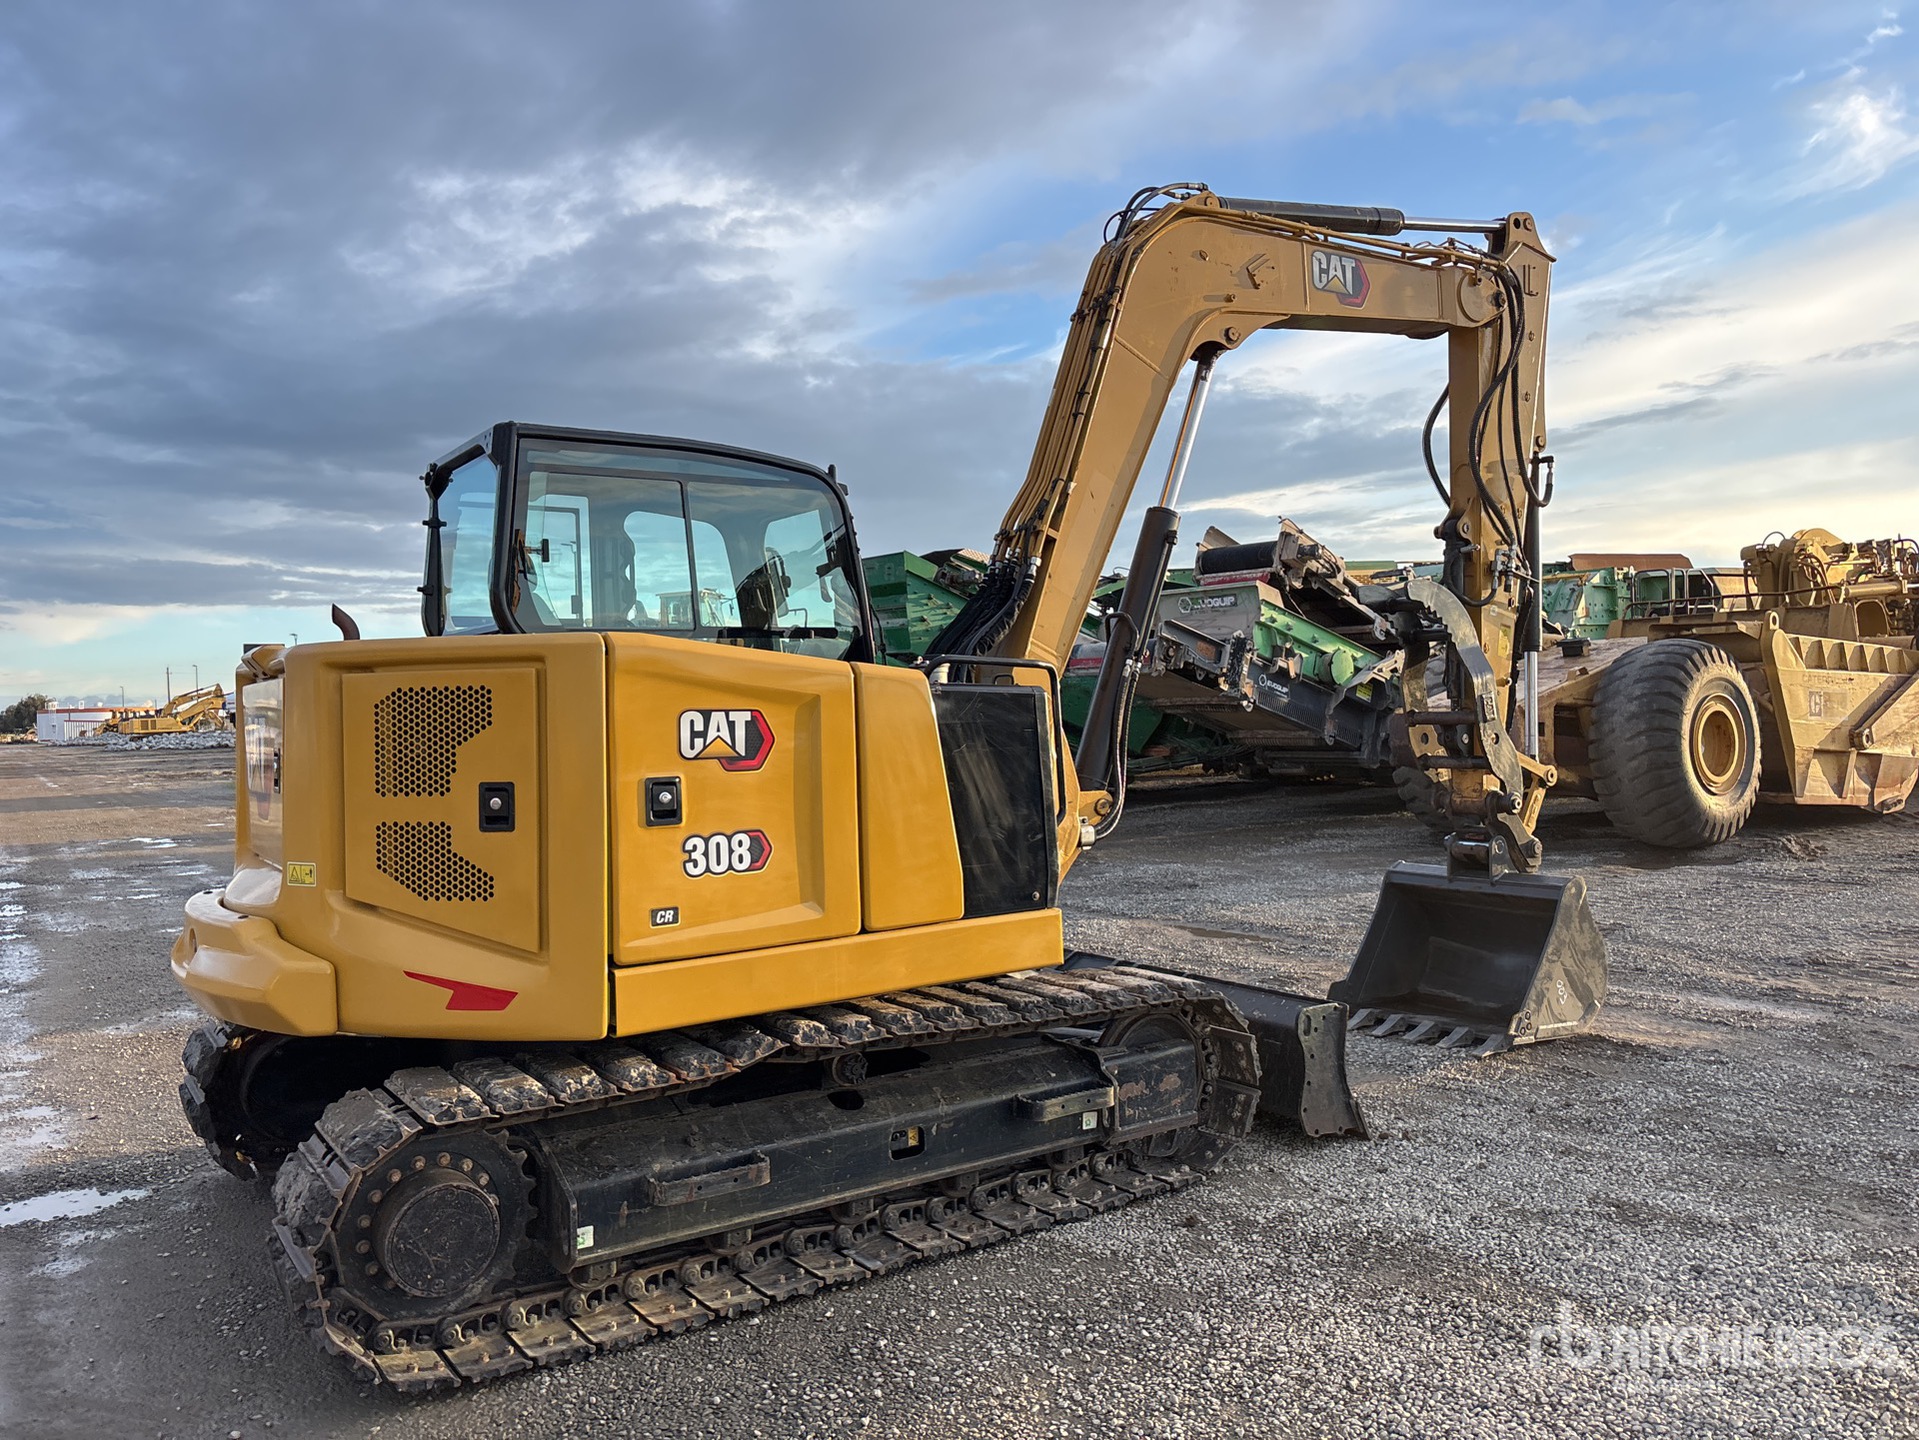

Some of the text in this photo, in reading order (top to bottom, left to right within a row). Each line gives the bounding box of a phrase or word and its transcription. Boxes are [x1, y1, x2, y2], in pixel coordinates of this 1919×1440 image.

[1312, 251, 1356, 295] CAT
[1194, 596, 1235, 608] VOQUIP
[679, 710, 752, 759] CAT
[684, 832, 752, 877] 308
[655, 909, 674, 924] CR
